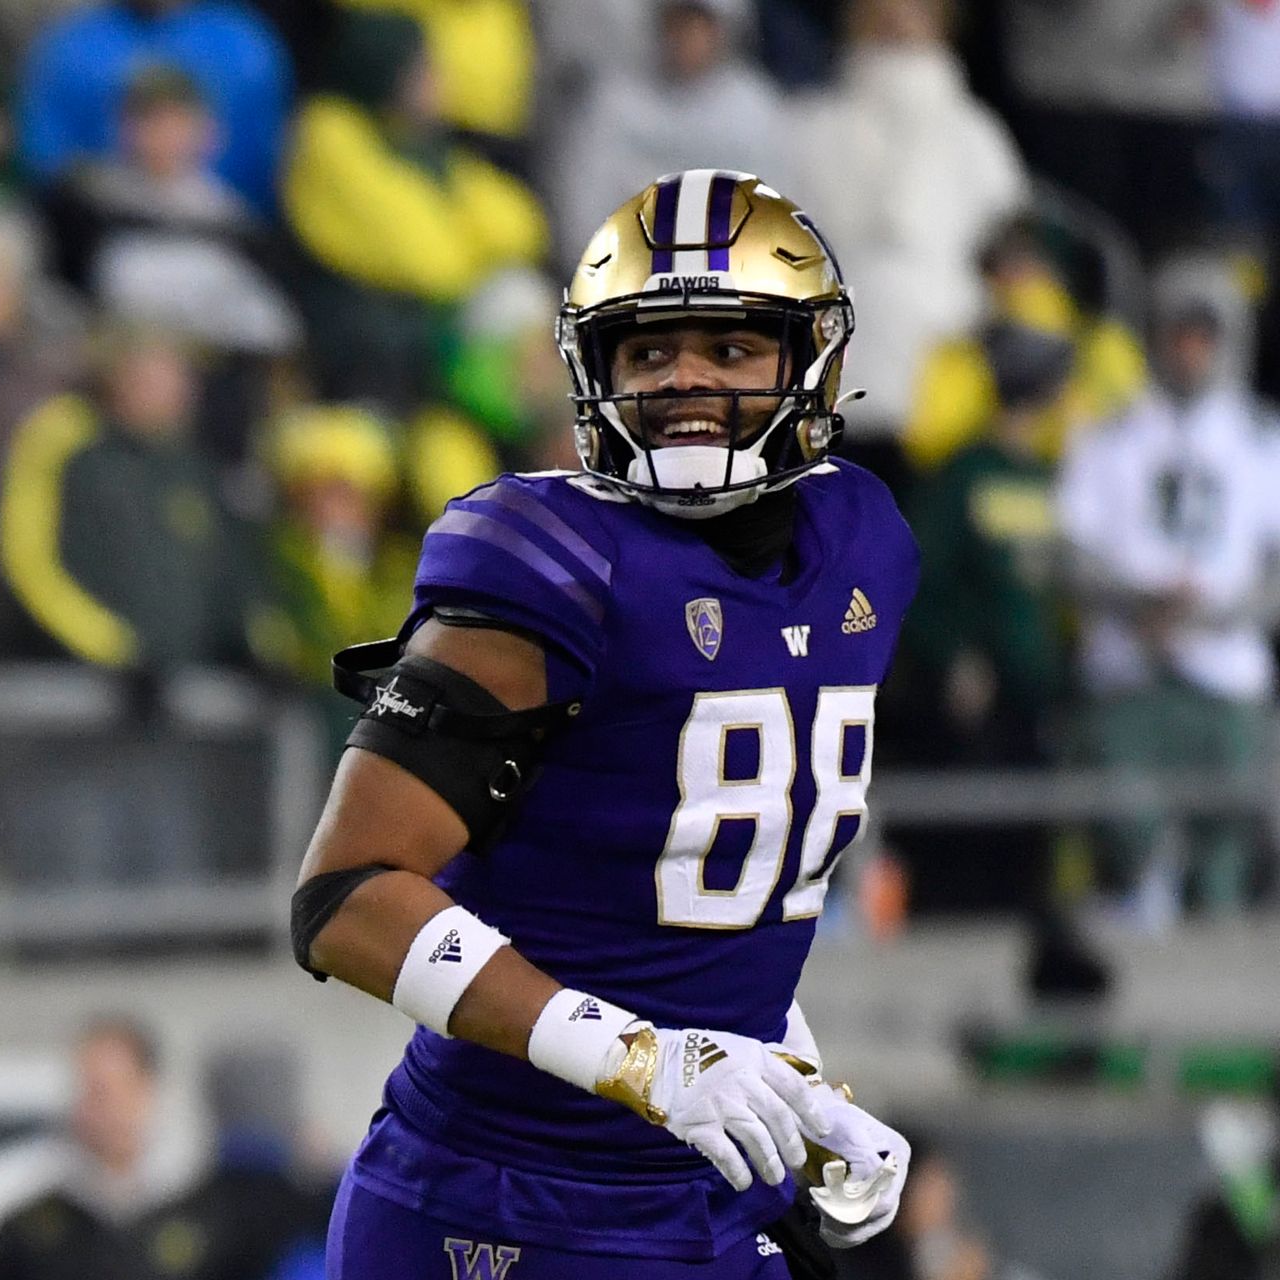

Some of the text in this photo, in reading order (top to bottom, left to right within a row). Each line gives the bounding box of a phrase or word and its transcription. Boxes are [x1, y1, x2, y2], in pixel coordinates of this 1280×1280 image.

[781, 625, 811, 656] W
[841, 615, 878, 634] adidas
[654, 683, 877, 930] 88
[429, 929, 458, 964] adidas
[683, 1032, 701, 1088] adidas
